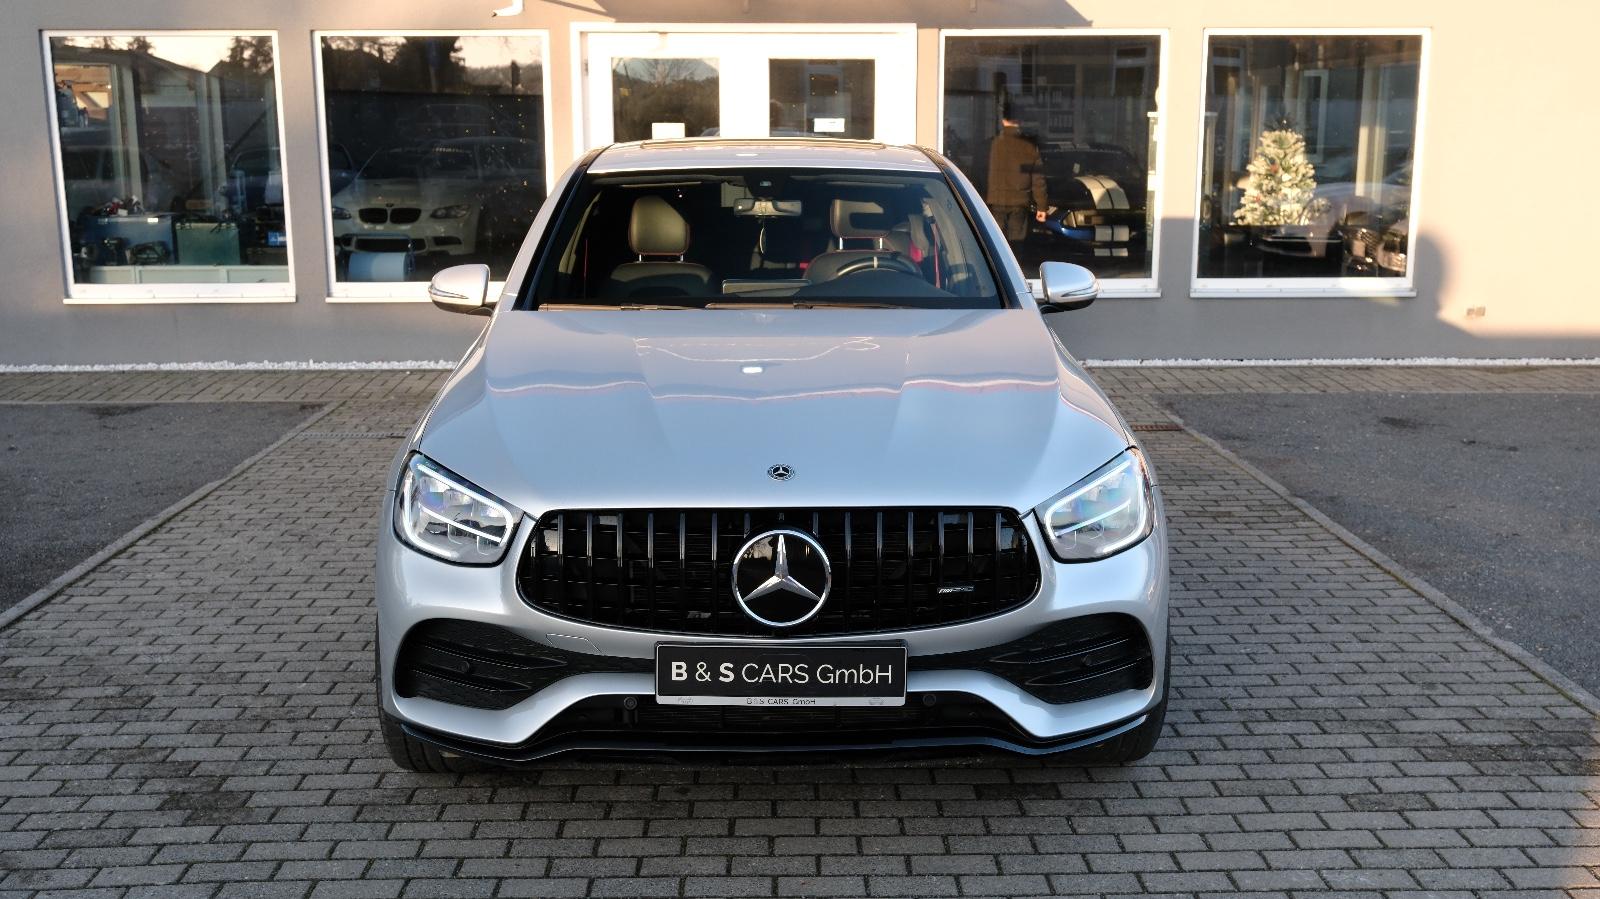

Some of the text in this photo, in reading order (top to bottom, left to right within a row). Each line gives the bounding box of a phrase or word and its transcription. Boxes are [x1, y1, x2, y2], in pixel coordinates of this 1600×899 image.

[671, 661, 893, 685] B & S CARS GmbH
